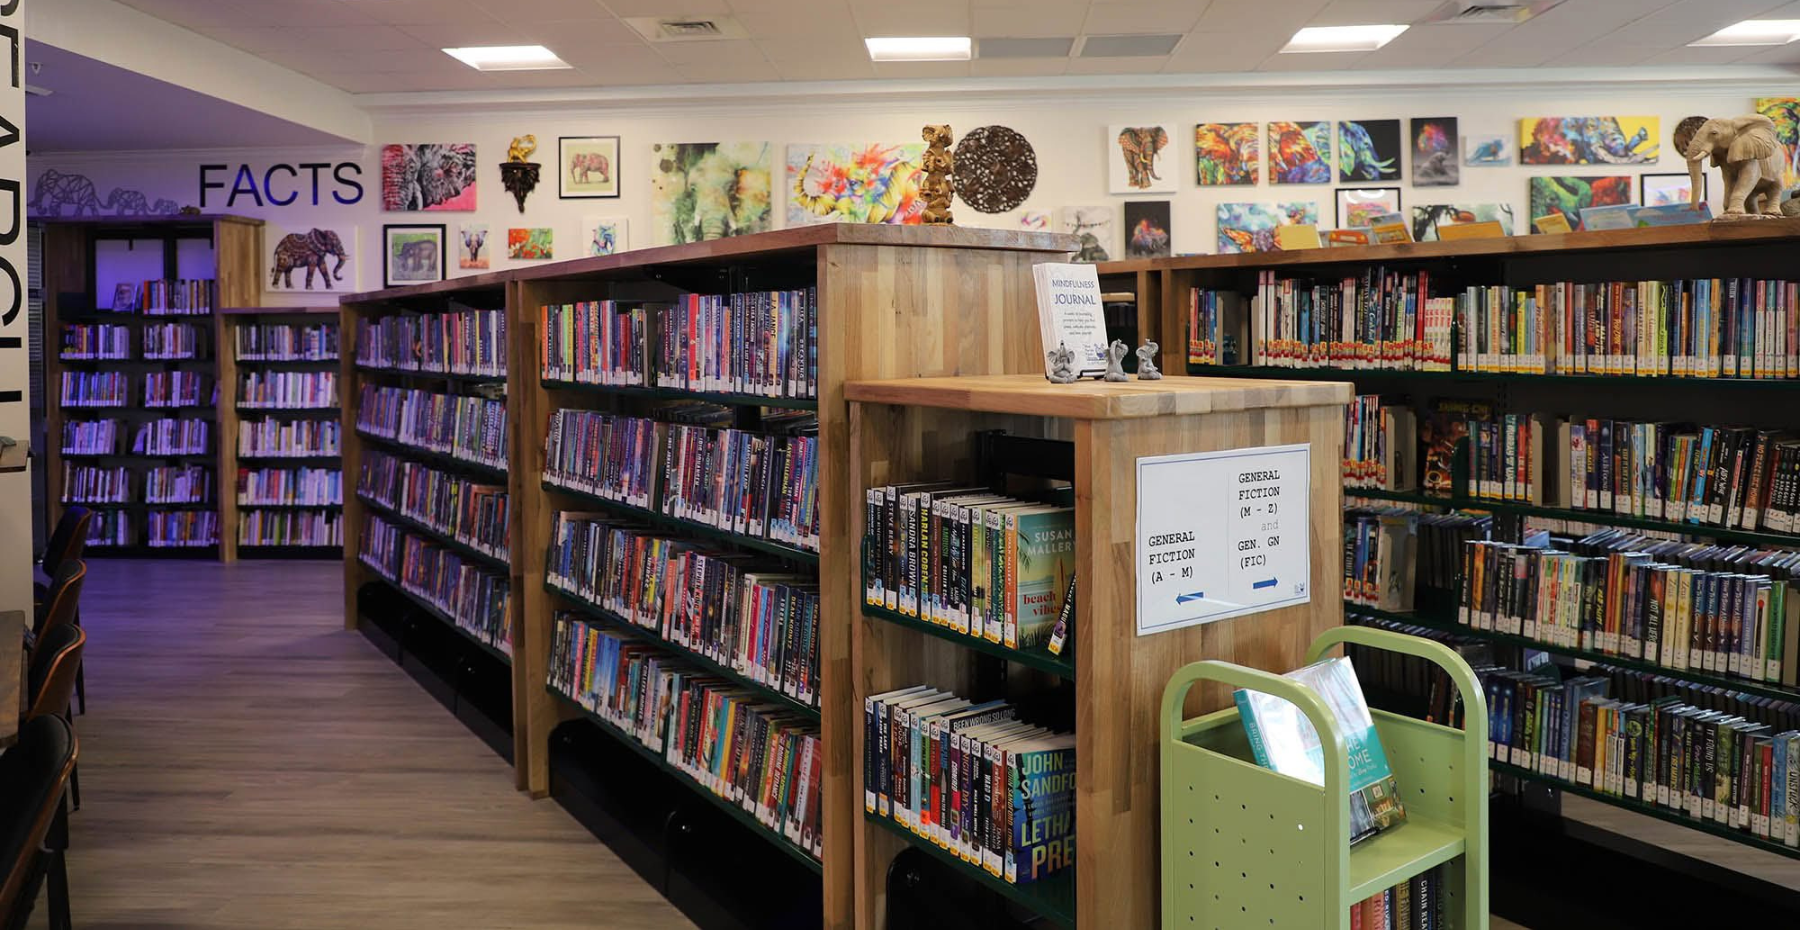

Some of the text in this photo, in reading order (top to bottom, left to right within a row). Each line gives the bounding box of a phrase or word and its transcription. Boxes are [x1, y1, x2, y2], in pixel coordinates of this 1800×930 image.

[198, 162, 365, 208] FACTS
[1052, 278, 1096, 290] MINDFULNESS
[1055, 293, 1098, 305] JOURNAL
[760, 441, 769, 490] KATZENBACH
[1749, 444, 1764, 504] NO PLACE LIKE HOME
[782, 458, 790, 495] KELLERMAN
[1238, 470, 1281, 484] GENERAL
[1239, 486, 1281, 500] FICTION
[1240, 506, 1251, 519] (M
[1268, 503, 1278, 514] Z)
[1261, 520, 1279, 532] and
[1034, 529, 1072, 543] SUSAN
[1148, 531, 1195, 547] GENERAL
[1238, 536, 1280, 551] GEN. GN
[908, 510, 917, 588] SANDRA BROWN
[920, 508, 929, 586] HARLAN COBEN
[1149, 548, 1196, 565] FICTION
[1240, 554, 1267, 569] (FIC)
[696, 559, 704, 589] STEPHEN
[1151, 571, 1163, 584] (A
[1182, 566, 1193, 578] M)
[1023, 590, 1057, 605] beach
[1668, 578, 1676, 598] Zeus
[1680, 580, 1689, 600] Zeus
[1032, 603, 1061, 617] vibes
[1650, 599, 1659, 613] NOT
[1649, 614, 1658, 625] ALL
[793, 622, 801, 653] KOONTZ
[809, 627, 817, 659] KOONTZ
[638, 694, 646, 720] HOOVER
[953, 708, 1016, 730] BEEN WRONG SO LONG
[1249, 722, 1263, 752] BRING
[1346, 737, 1361, 755] HE
[774, 745, 784, 769] BOURNE
[1705, 738, 1714, 760] FOUND
[1021, 752, 1064, 776] JOHN
[1348, 751, 1373, 770] OME
[1705, 762, 1714, 774] US
[1788, 771, 1799, 810] UNSTUCK
[1420, 880, 1428, 909] CHAIN
